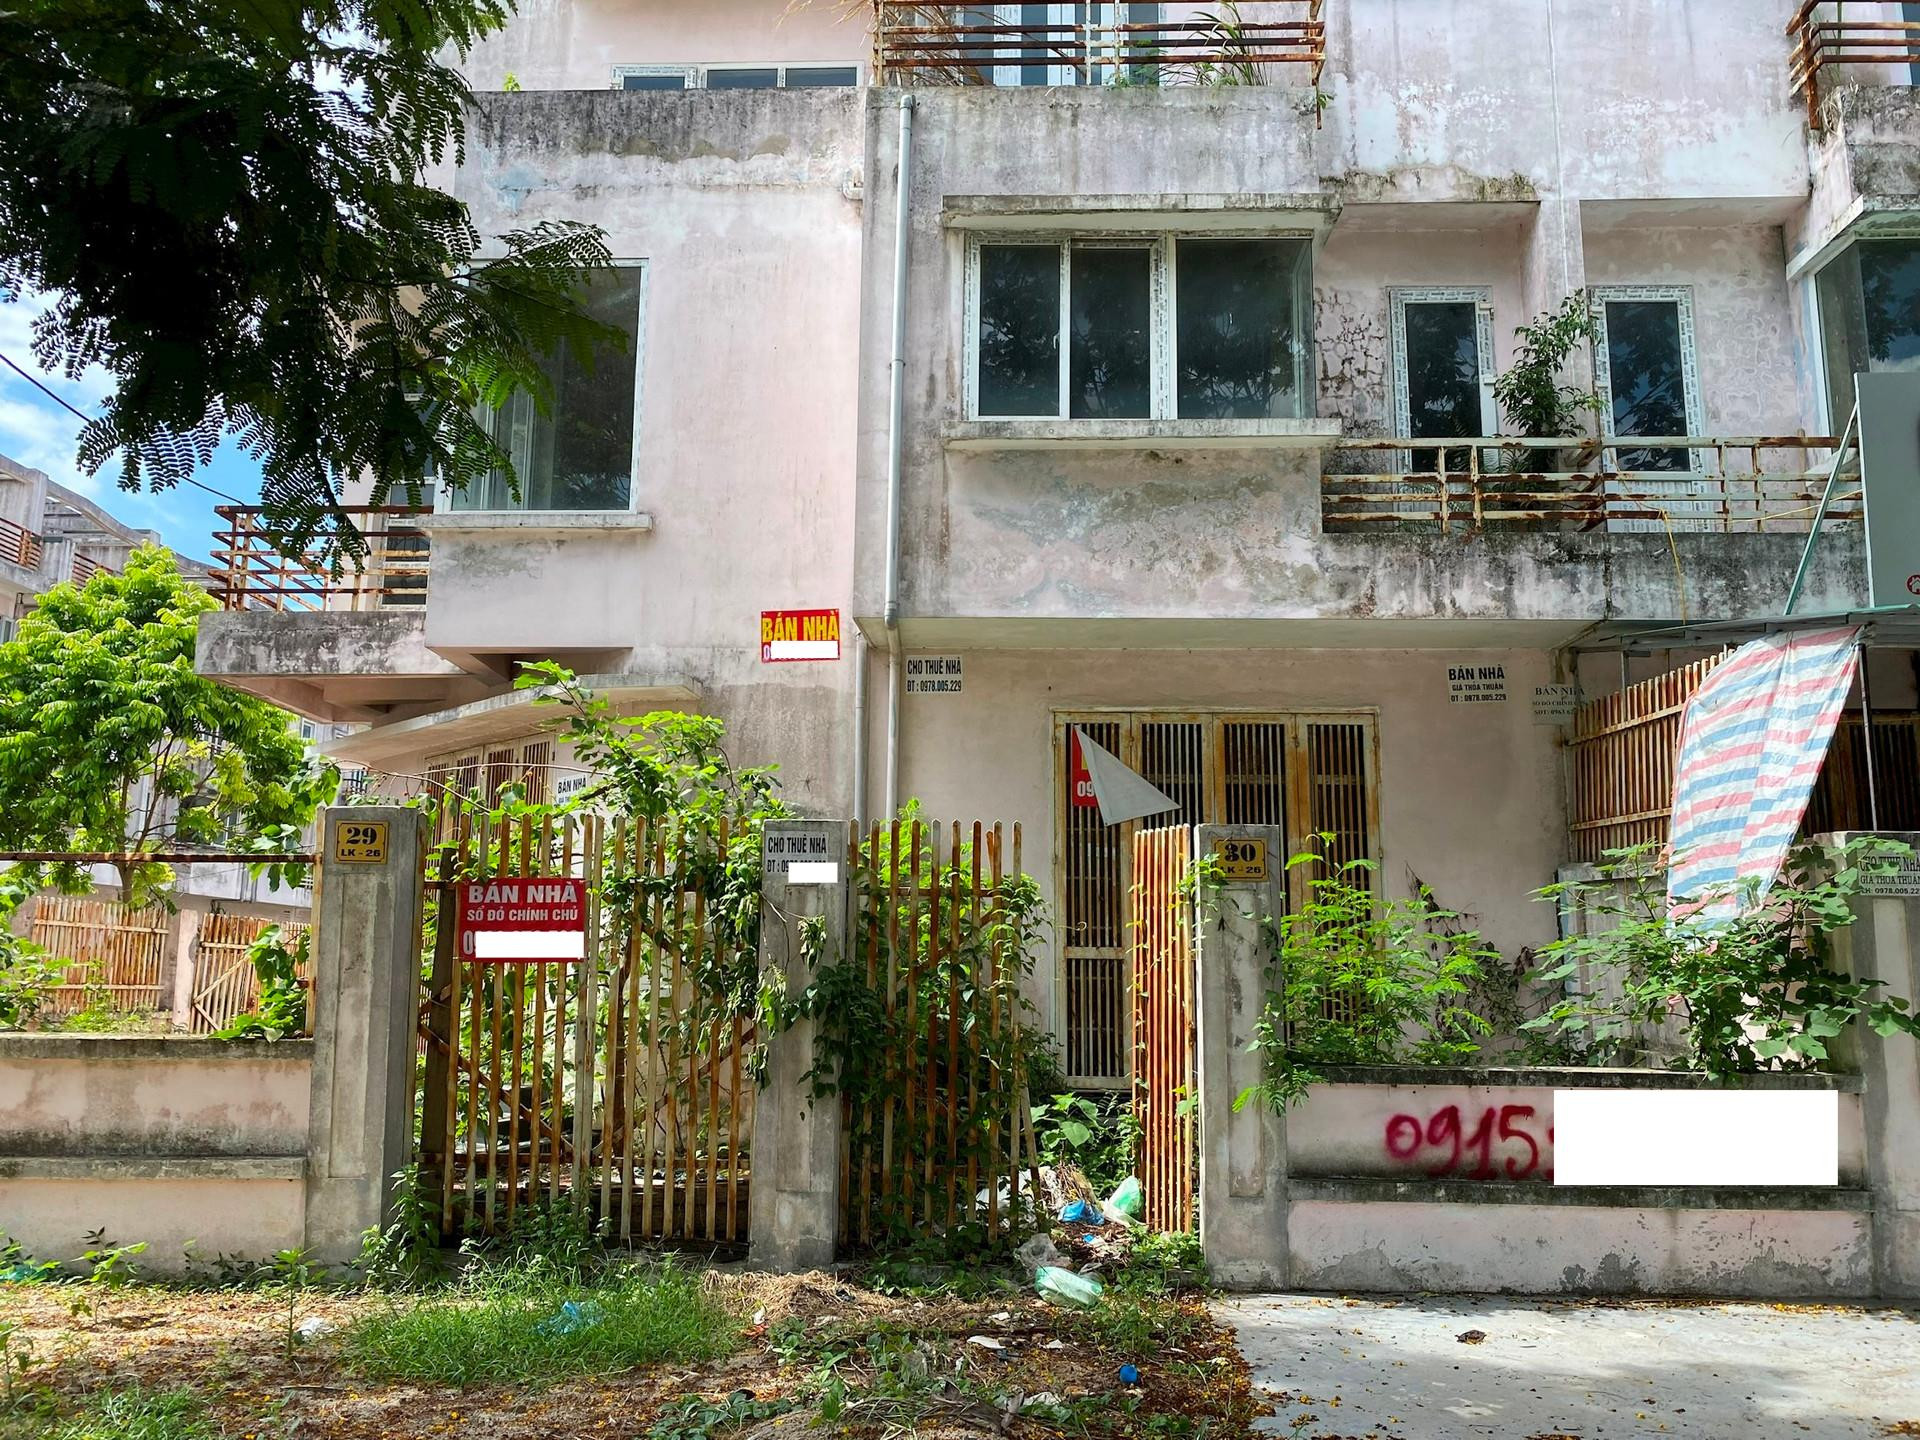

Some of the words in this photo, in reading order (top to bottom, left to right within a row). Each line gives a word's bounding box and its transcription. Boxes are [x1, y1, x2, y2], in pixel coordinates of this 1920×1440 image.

[762, 612, 798, 643] BÁN
[803, 610, 839, 641] NHÀ
[907, 659, 923, 674] CHO
[925, 656, 943, 674] THUÊ
[945, 656, 962, 674] NHÀ
[1448, 665, 1475, 681] BÁN
[1479, 663, 1505, 680] NHÀ
[558, 778, 572, 794] BÁN
[573, 775, 587, 791] NHÀ
[346, 827, 377, 845] 29
[768, 837, 784, 853] CHO
[787, 834, 807, 853] THUÊ
[809, 834, 827, 853] NHÀ
[341, 849, 356, 857] LK
[365, 849, 381, 857] 26
[1224, 843, 1256, 862] 30
[468, 881, 519, 903] BÁN
[526, 881, 578, 903] NHÀ
[467, 905, 484, 921] SỔ
[487, 906, 505, 921] ĐỎ
[509, 906, 549, 921] CHÍNH
[552, 905, 578, 921] CHỦ
[1386, 1104, 1554, 1180] 0915
